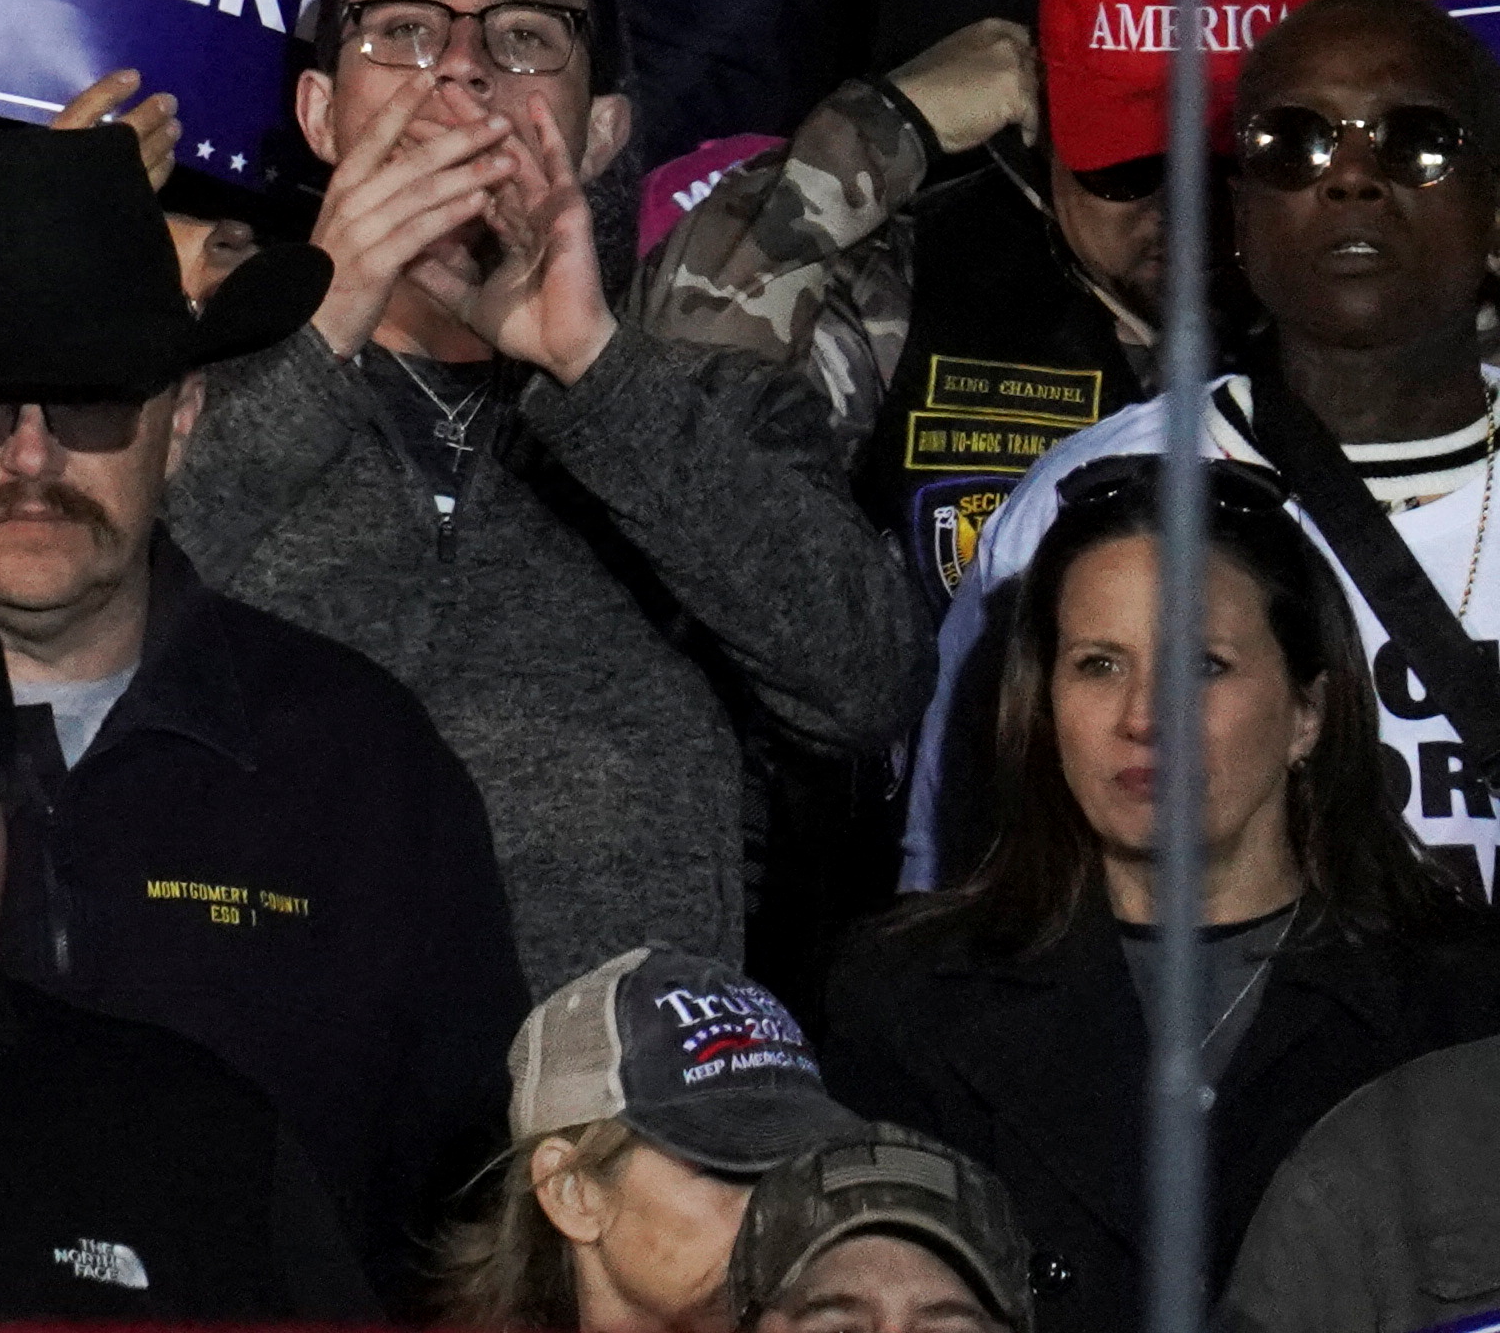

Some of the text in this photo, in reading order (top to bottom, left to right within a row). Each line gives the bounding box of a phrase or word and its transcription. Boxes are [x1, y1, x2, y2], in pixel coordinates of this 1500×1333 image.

[999, 379, 1086, 404] CHANNEL
[147, 880, 309, 917] MONTGOMERY COUNTY
[683, 1060, 726, 1085] KEEP
[79, 1238, 113, 1253] THE
[54, 1247, 118, 1267] NORTH
[74, 1262, 119, 1282] FACE
